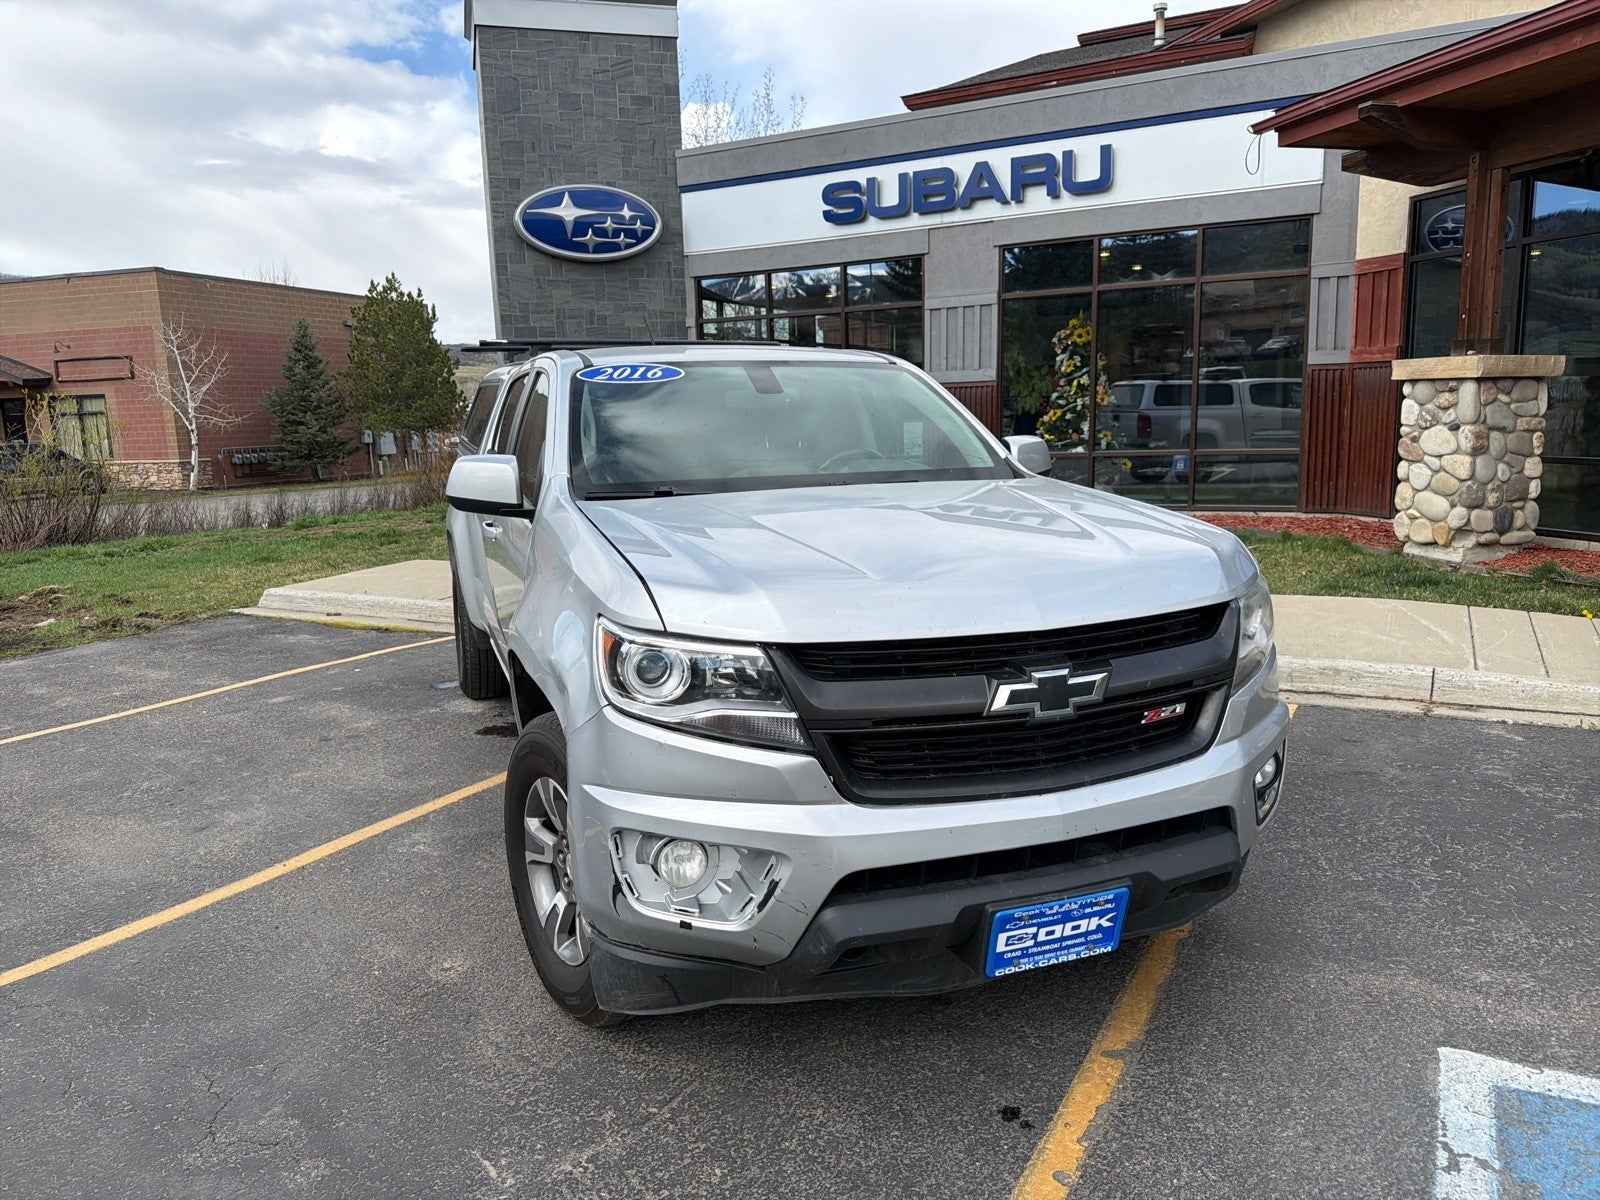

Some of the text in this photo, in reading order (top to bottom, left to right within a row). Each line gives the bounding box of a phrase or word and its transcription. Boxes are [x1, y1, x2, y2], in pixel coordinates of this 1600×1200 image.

[822, 144, 1113, 224] SUBARU
[593, 366, 664, 380] 2016
[1141, 703, 1186, 723] Z71
[1063, 894, 1115, 908] ALTITUDE
[1084, 903, 1115, 913] SUBARU
[1026, 915, 1062, 924] CHEVROLET
[1028, 943, 1060, 953] STEAMBOAT
